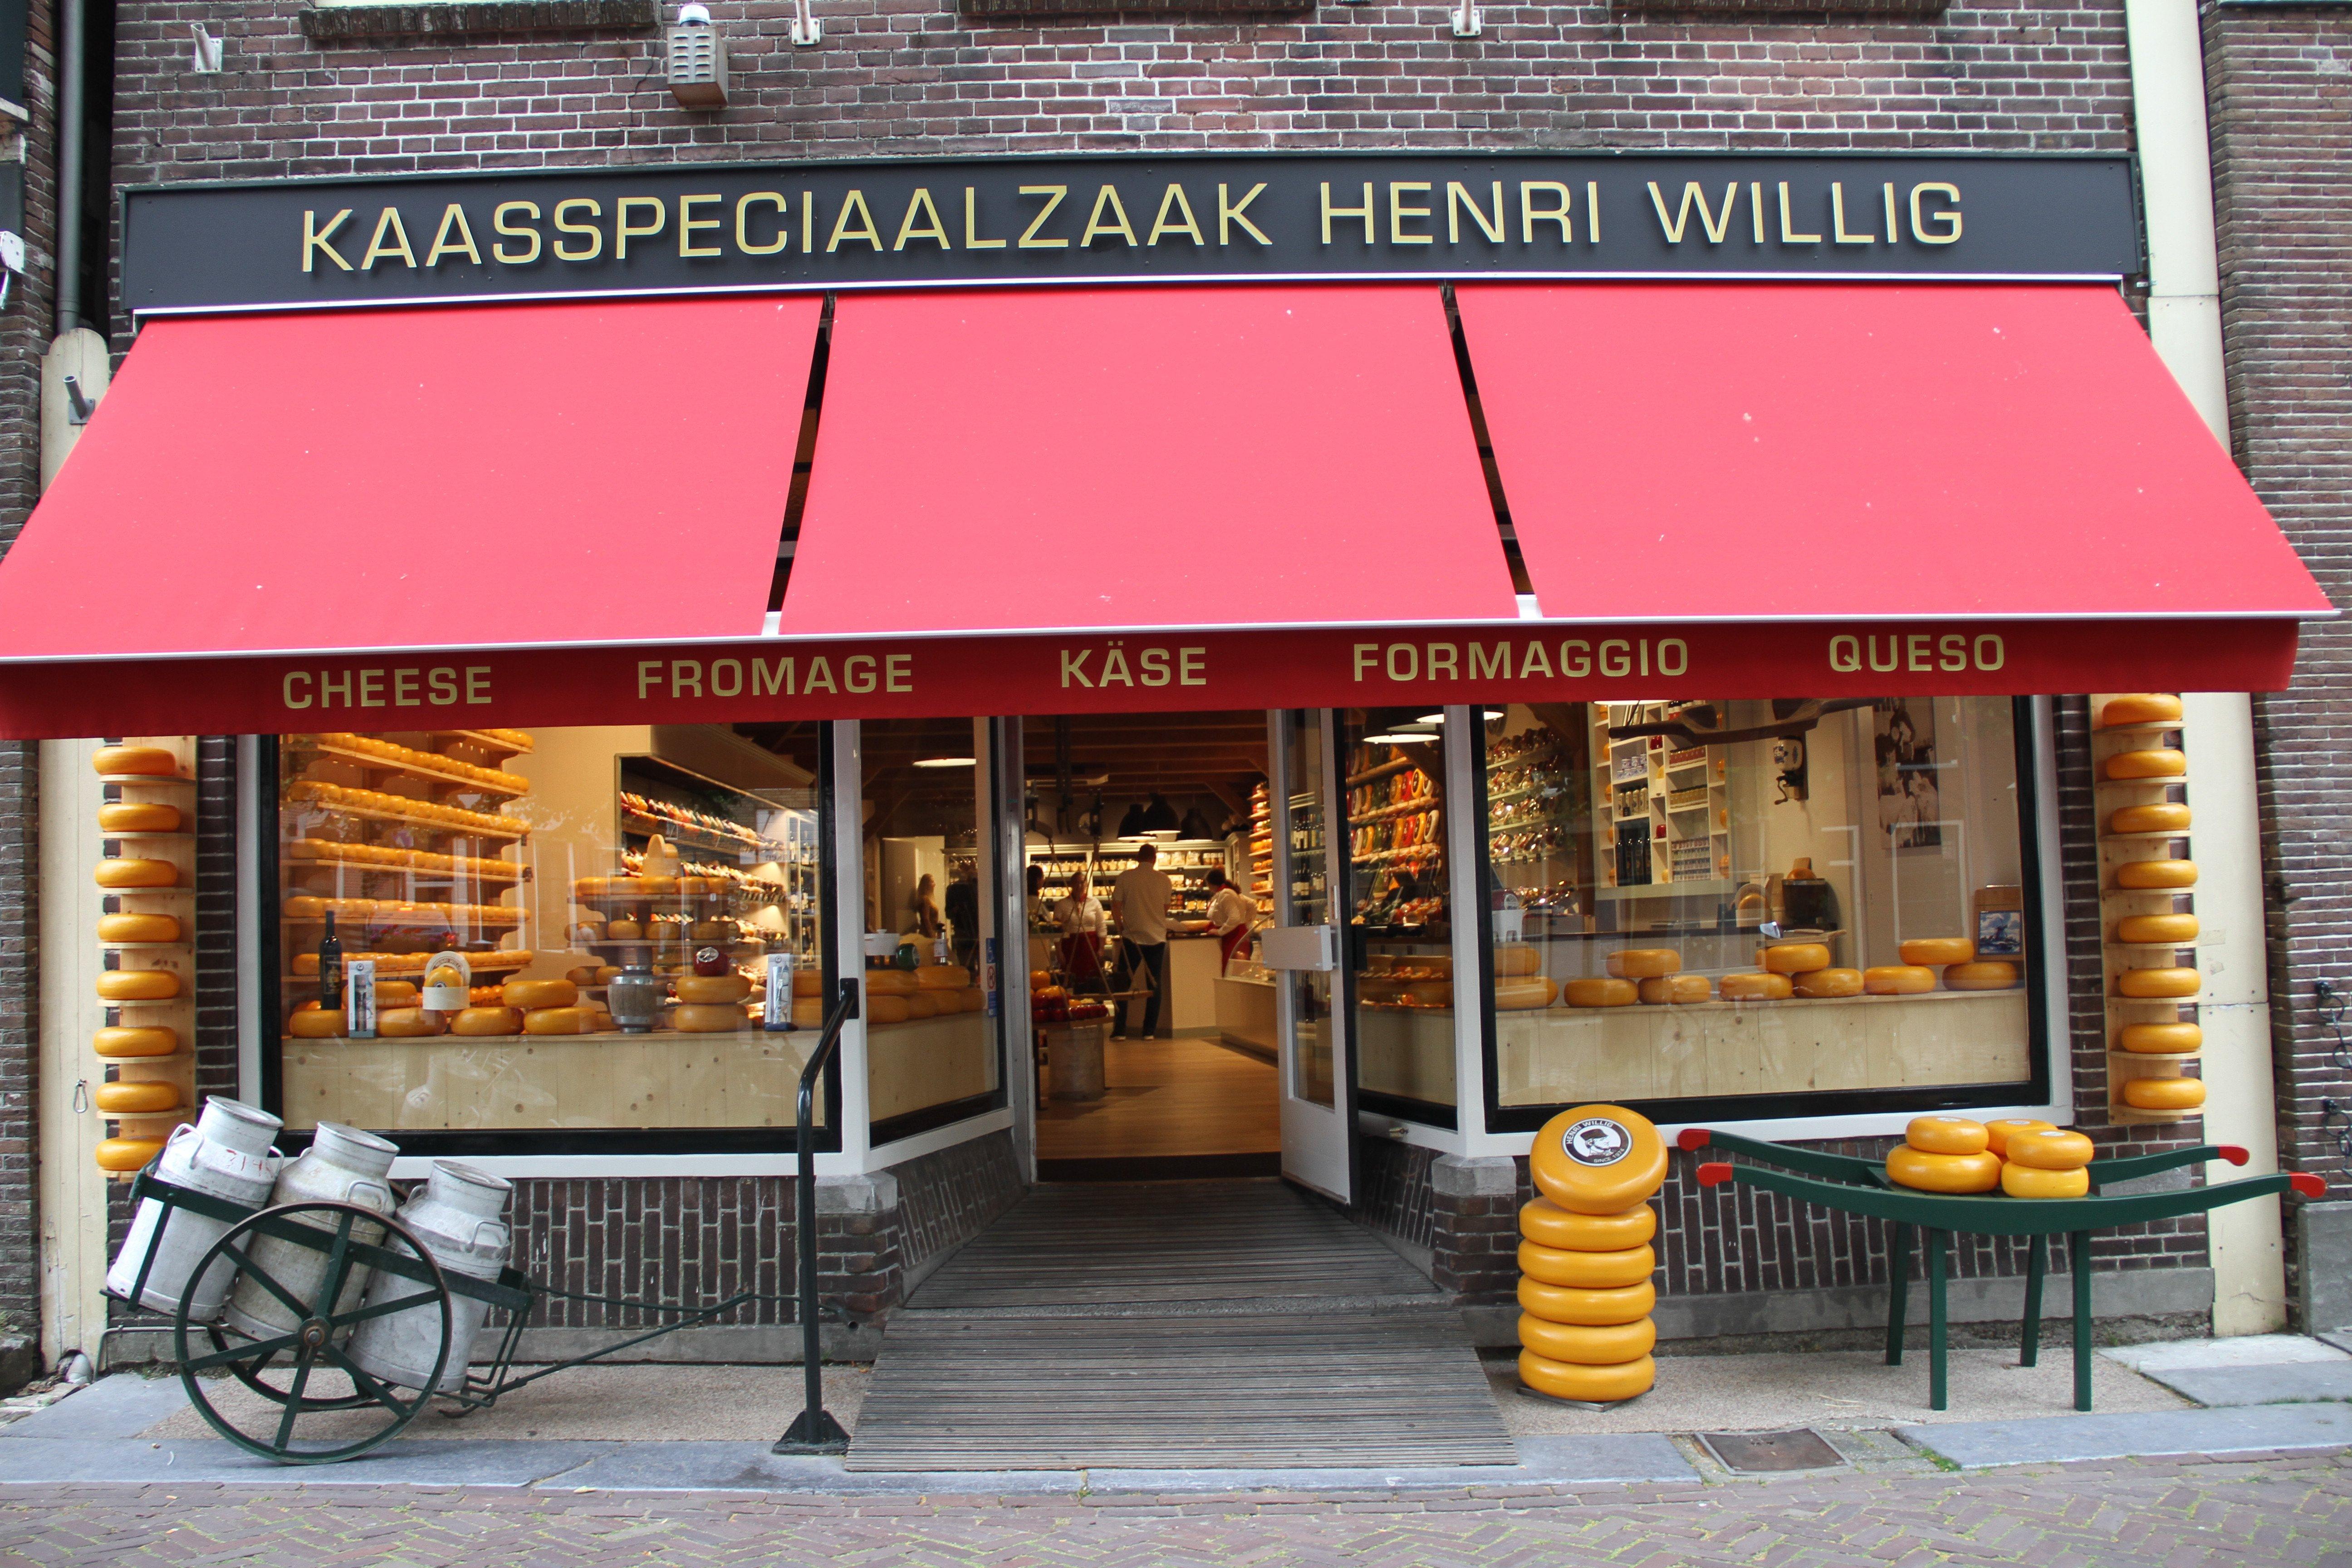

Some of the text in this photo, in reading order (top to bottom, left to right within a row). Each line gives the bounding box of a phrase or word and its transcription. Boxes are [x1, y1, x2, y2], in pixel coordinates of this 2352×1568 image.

[302, 181, 1963, 272] KAASSPECIAALZAAK HENRI WILLIG
[1060, 641, 1207, 688] KÄSE
[1353, 638, 1689, 682] FORMAGGIO
[1828, 633, 2005, 672] QUESO
[283, 665, 492, 709] CHEESE
[637, 654, 913, 699] FROMAGE
[1566, 1125, 1582, 1144] HENRI
